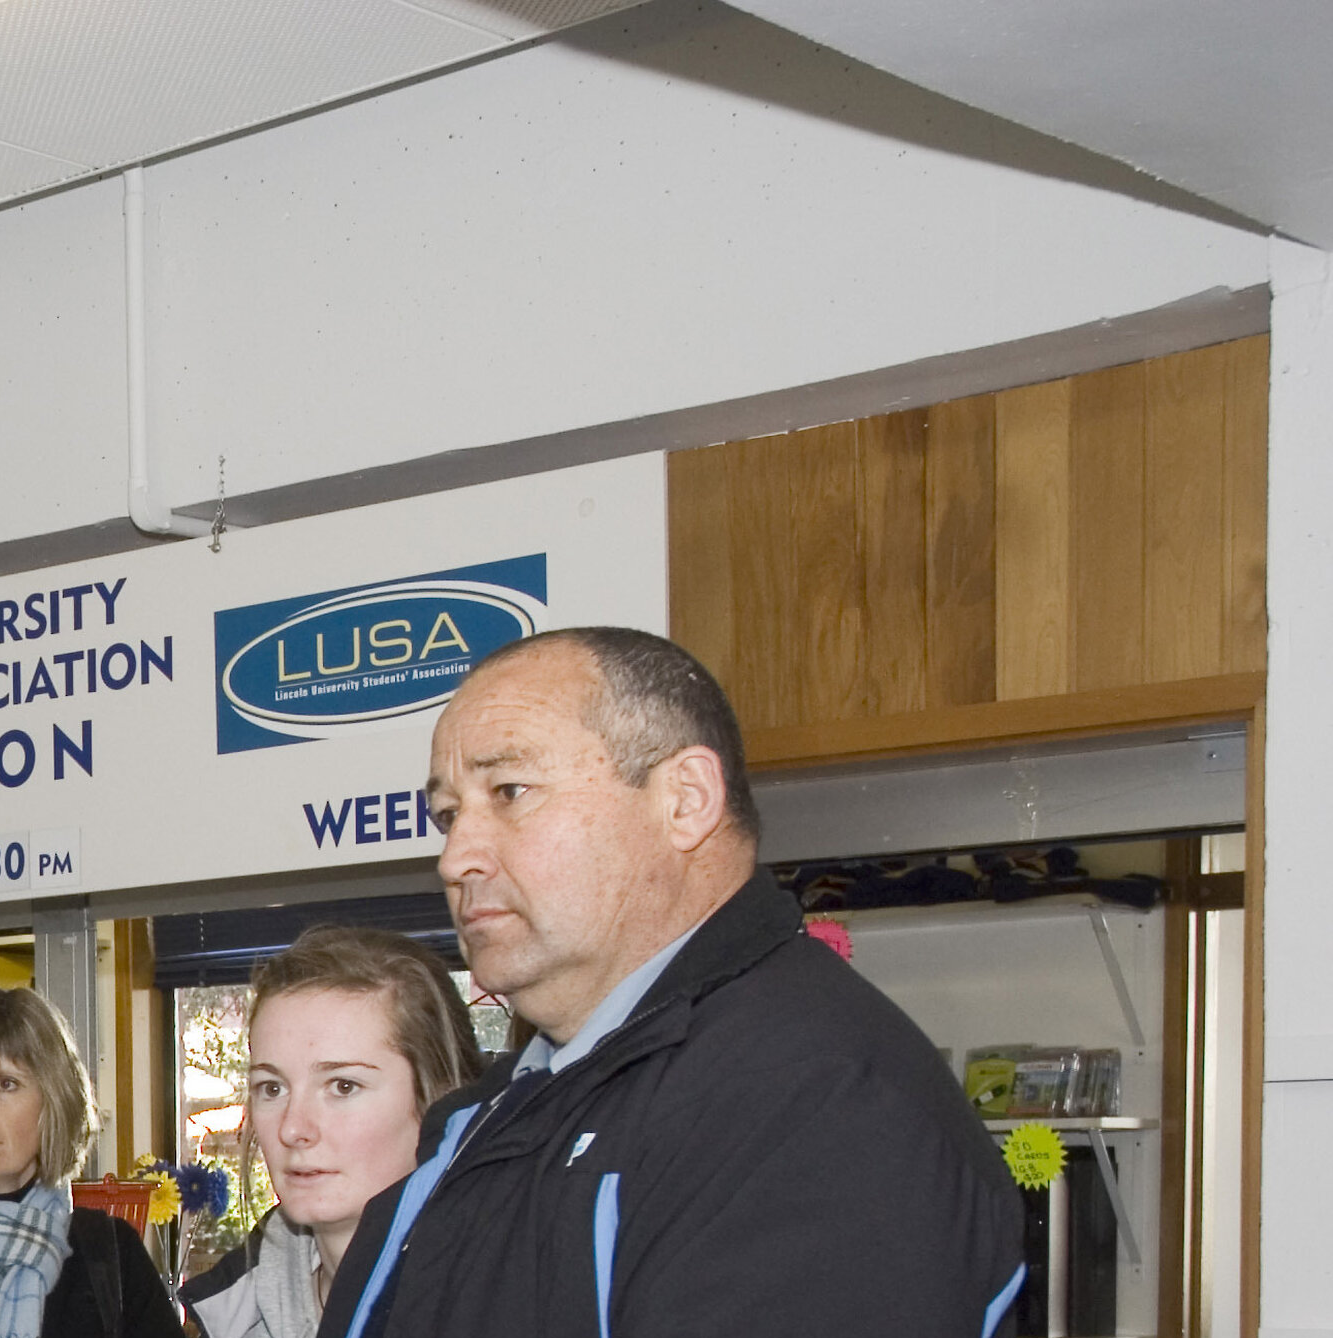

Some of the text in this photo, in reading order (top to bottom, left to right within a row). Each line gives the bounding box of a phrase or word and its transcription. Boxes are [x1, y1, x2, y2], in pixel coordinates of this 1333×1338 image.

[276, 611, 470, 683] LUSA
[275, 663, 470, 701] Lincoln University Students' Association
[39, 851, 72, 876] PM
